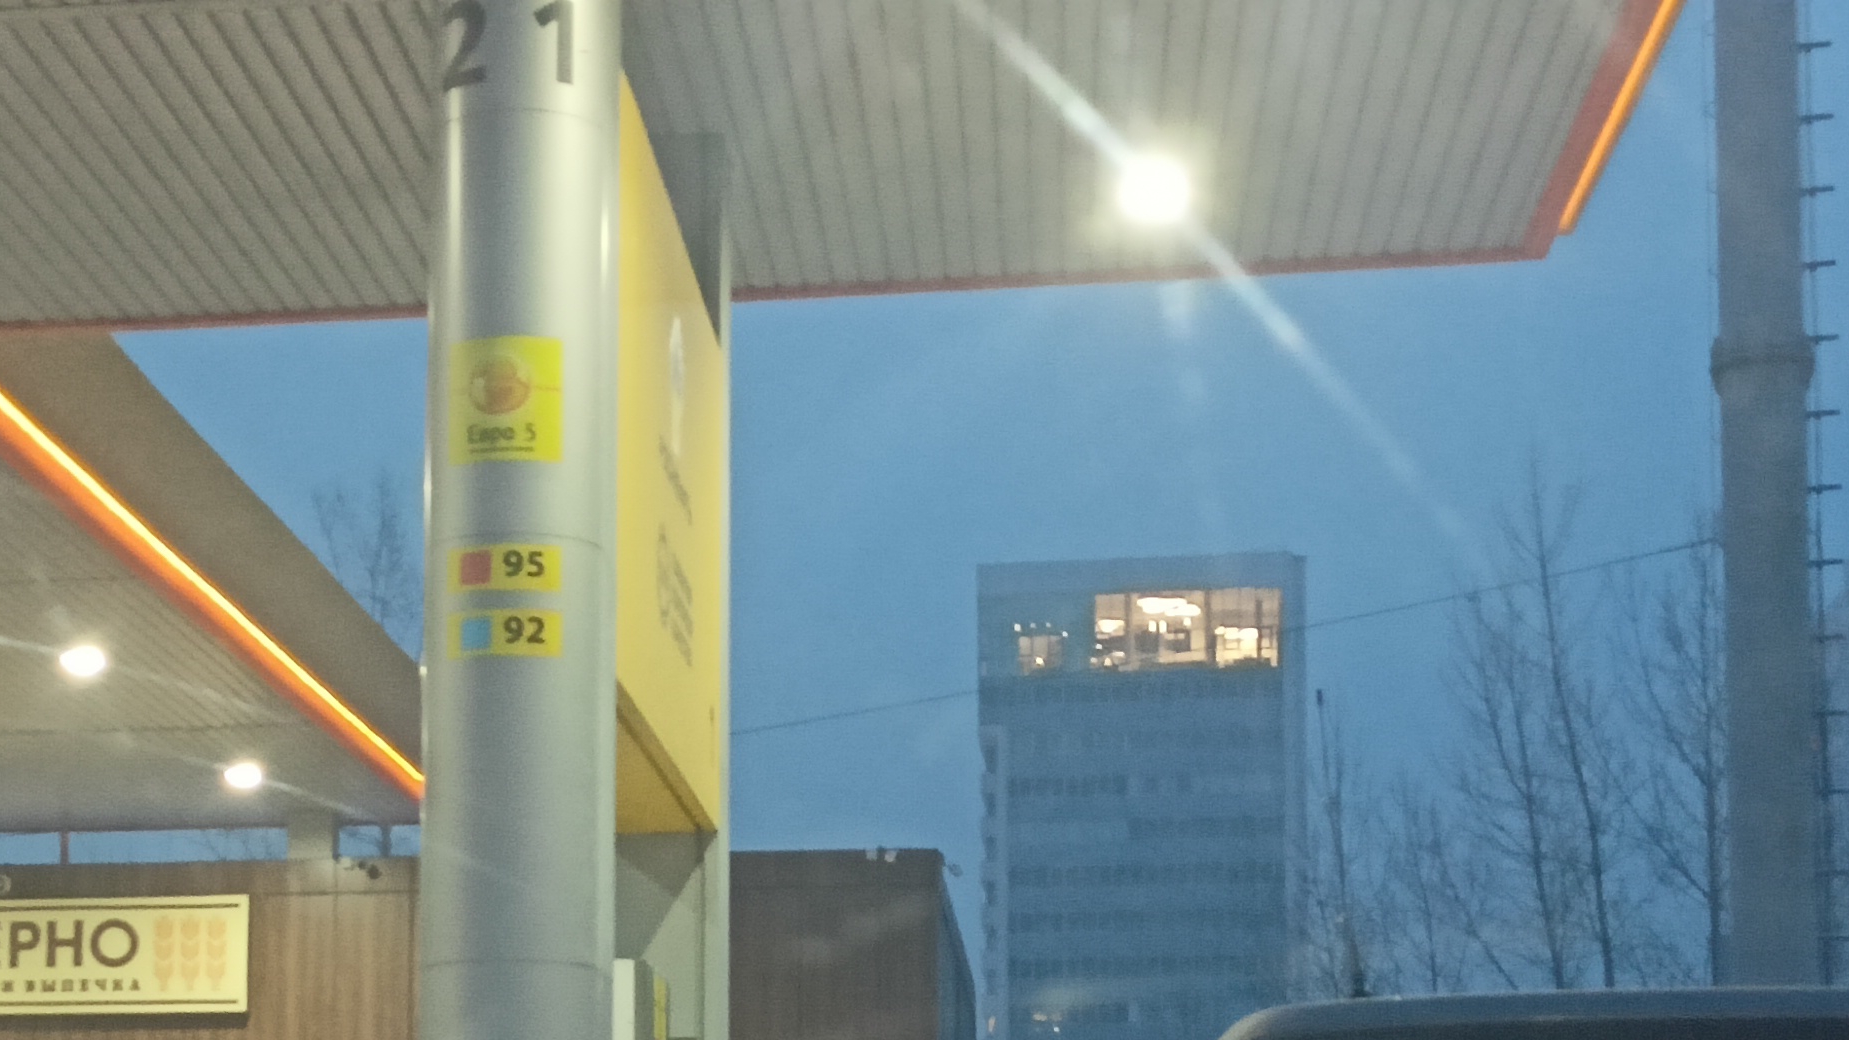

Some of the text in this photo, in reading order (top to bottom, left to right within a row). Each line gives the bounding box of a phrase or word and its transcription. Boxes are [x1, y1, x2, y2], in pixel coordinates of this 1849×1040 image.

[443, 0, 573, 91] 2 1
[524, 422, 537, 442] 5
[502, 549, 545, 578] 95
[502, 615, 545, 644] 92
[25, 977, 141, 994] ВЫПЕЧКА
